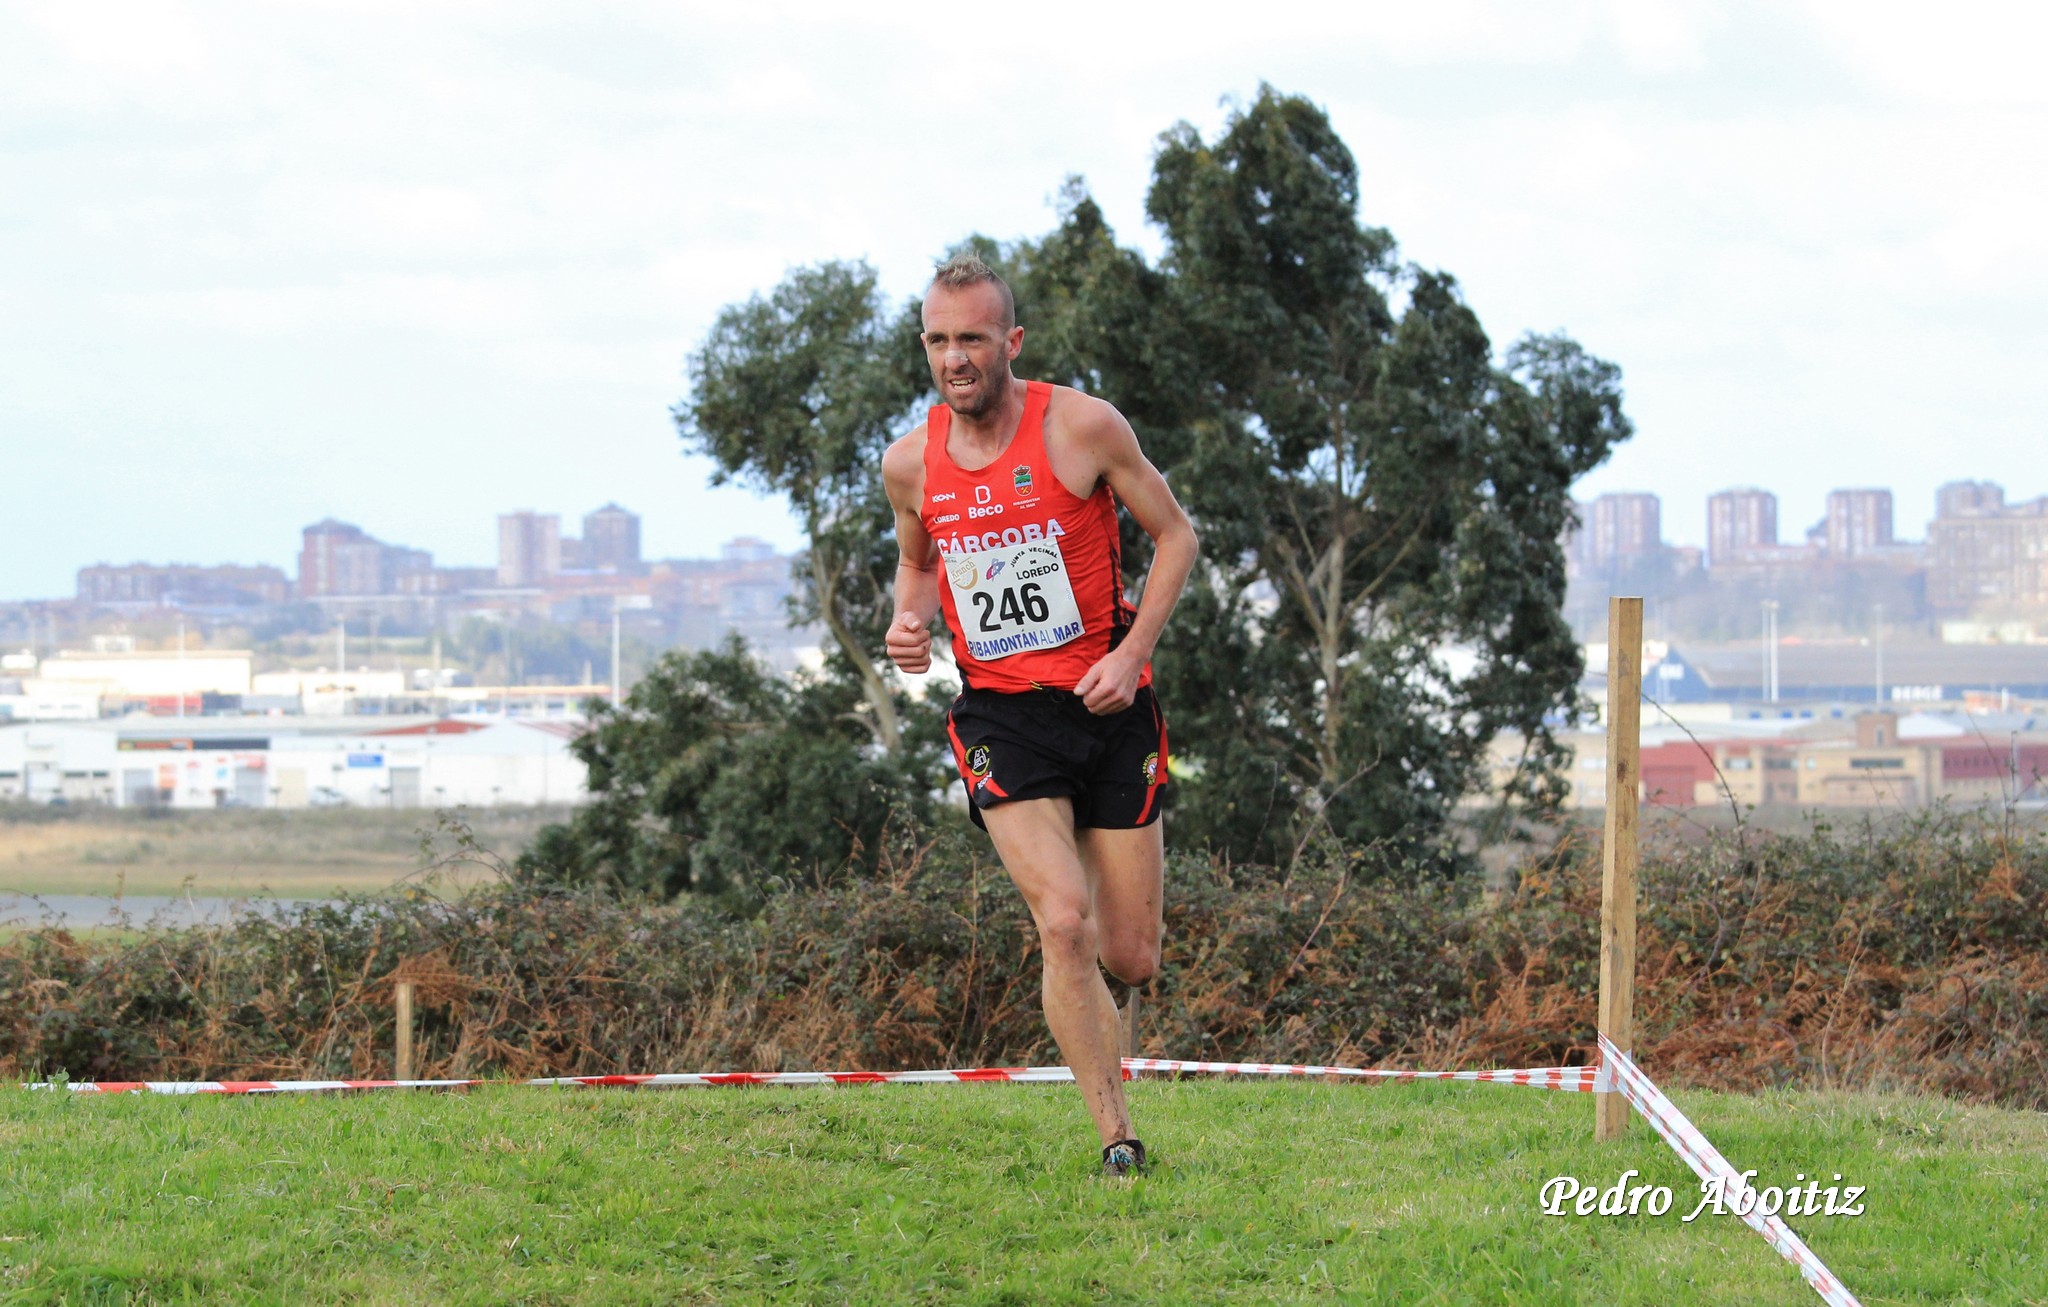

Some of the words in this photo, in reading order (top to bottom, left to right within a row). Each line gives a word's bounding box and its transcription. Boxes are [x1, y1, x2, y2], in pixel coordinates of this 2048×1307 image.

[933, 513, 960, 524] LOREDO
[968, 504, 1004, 519] Beco
[937, 518, 1066, 554] CÁRCOBA
[1010, 550, 1025, 567] JUNTA
[1028, 547, 1058, 559] VECINAL
[1016, 563, 1059, 580] LOREDO
[972, 582, 1049, 633] 246
[968, 628, 1039, 657] RIBAMONTÁN
[1040, 628, 1054, 645] AL
[1054, 621, 1081, 643] MAR
